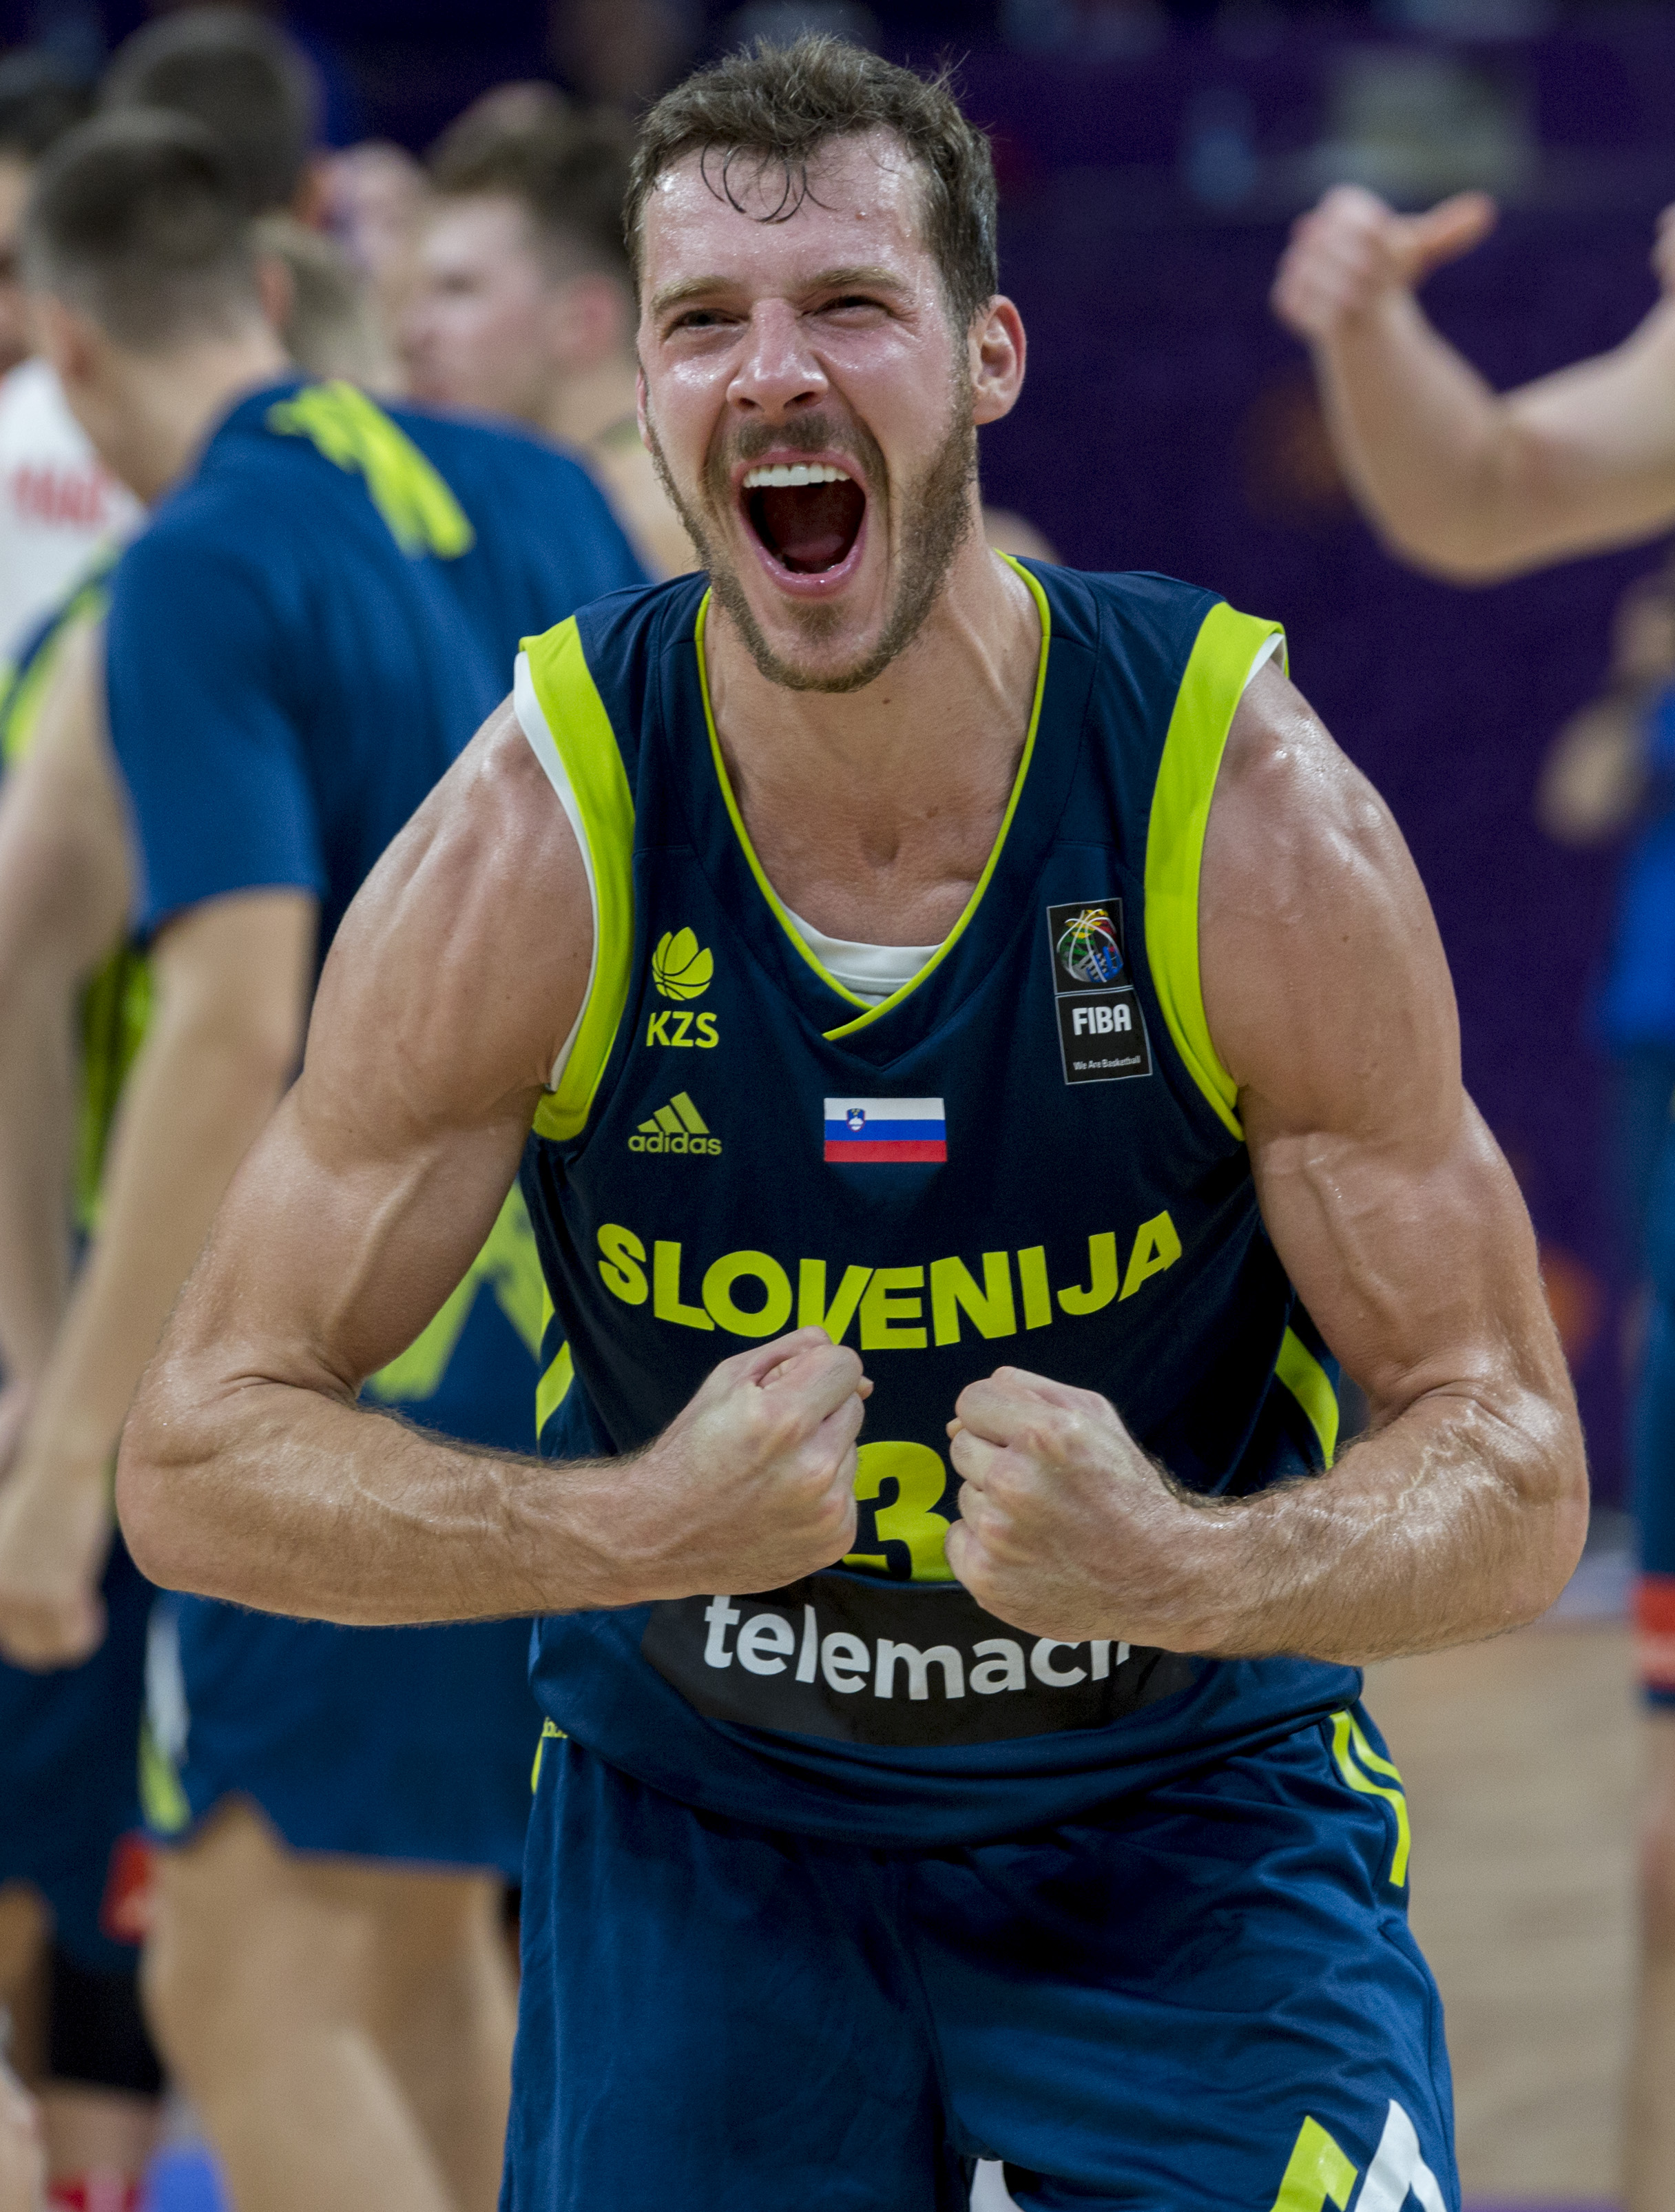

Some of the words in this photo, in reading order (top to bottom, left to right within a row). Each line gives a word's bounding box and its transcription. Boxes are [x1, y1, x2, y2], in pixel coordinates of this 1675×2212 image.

[646, 1011, 720, 1048] KZS
[1072, 1004, 1132, 1035] FIBA
[1073, 1061, 1088, 1071] We
[1088, 1060, 1102, 1068] Are
[1102, 1055, 1141, 1068] Basketball
[627, 1131, 722, 1155] adidas
[597, 1210, 1182, 1350] SLOVENIJA
[842, 1441, 956, 1582] 3
